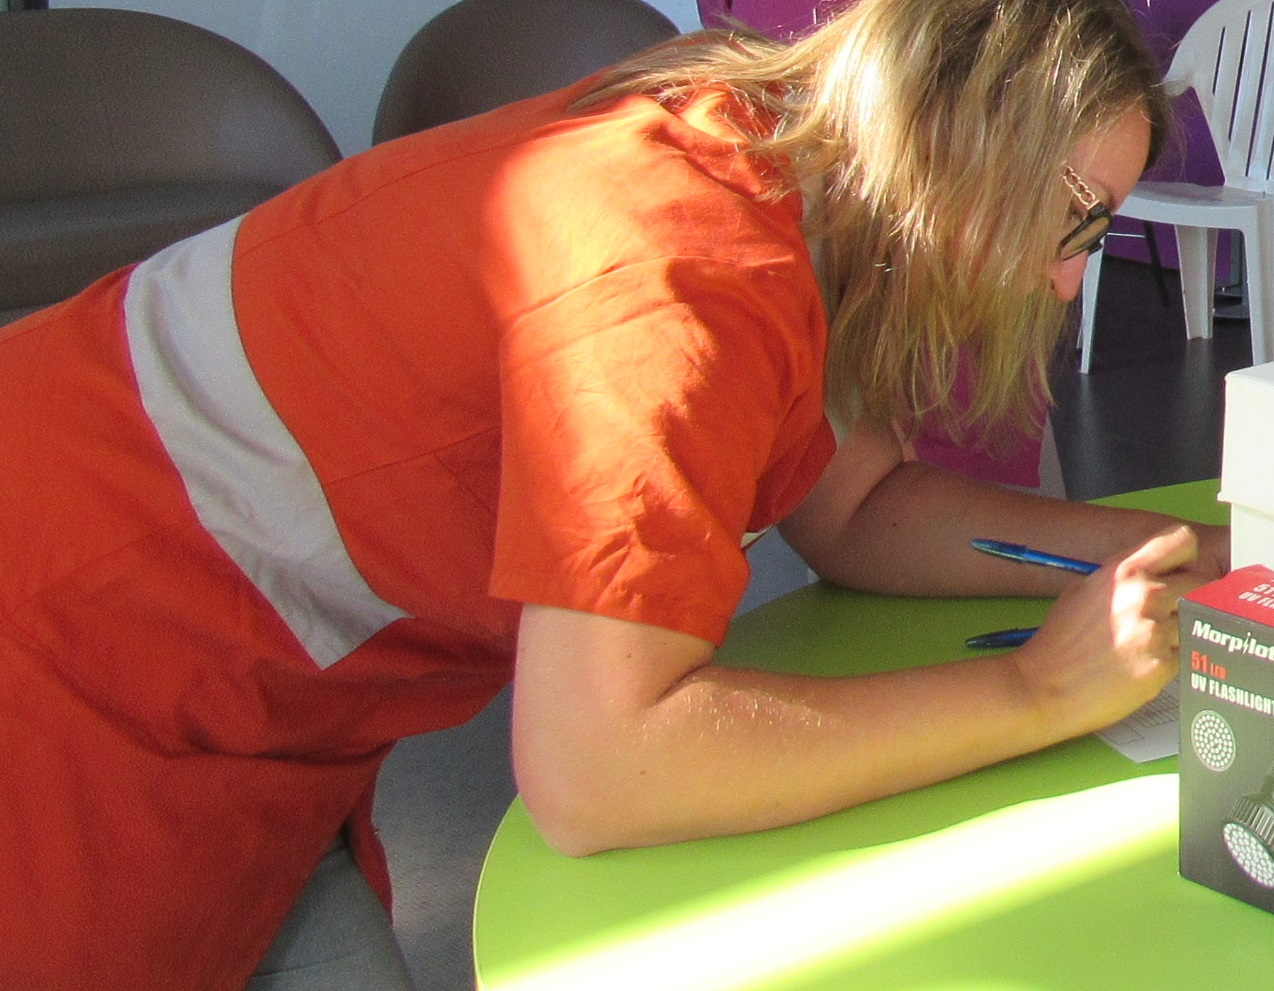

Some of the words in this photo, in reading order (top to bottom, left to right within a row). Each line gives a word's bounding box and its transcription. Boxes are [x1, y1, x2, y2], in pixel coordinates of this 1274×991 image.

[1238, 591, 1262, 602] UV
[1190, 650, 1210, 674] 51
[1191, 672, 1208, 692] UV
